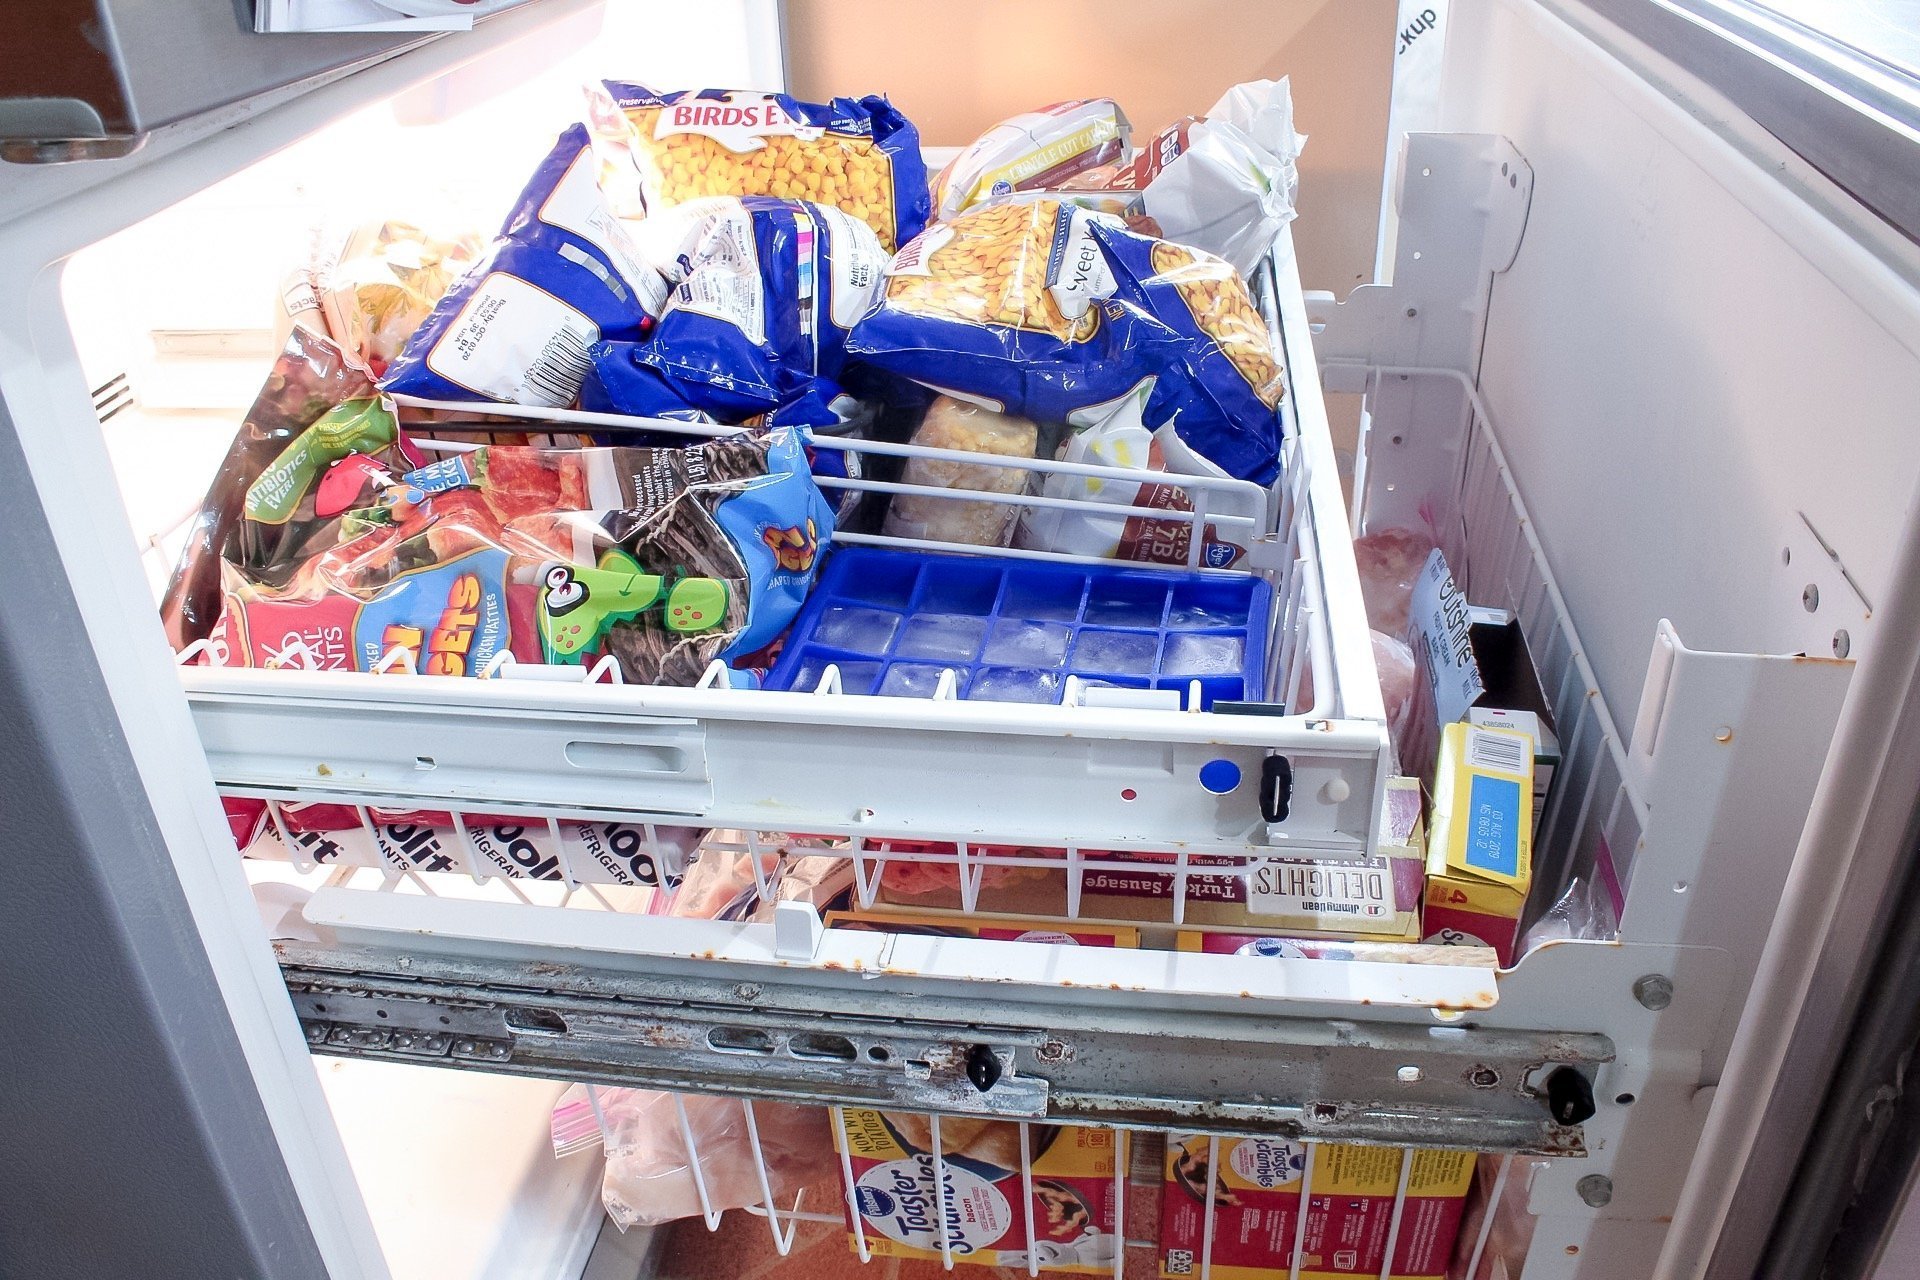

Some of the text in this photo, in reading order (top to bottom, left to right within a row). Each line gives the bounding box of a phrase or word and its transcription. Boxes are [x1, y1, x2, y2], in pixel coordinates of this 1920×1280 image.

[674, 106, 759, 127] BIRDS
[1008, 148, 1057, 180] CRINKLE
[1058, 139, 1078, 157] CUT
[858, 264, 869, 288] Facts
[1066, 245, 1098, 292] Sweet
[290, 295, 320, 311] acts
[492, 298, 507, 315] Best
[469, 321, 480, 334] 39
[484, 313, 495, 327] By:
[457, 338, 470, 351] B4
[475, 326, 486, 345] OCT
[541, 331, 564, 359] 14500
[462, 349, 472, 361] 20
[523, 356, 544, 382] 02439
[246, 450, 307, 512] ANTIBIOTICS
[264, 476, 297, 511] EVER!
[634, 475, 644, 506] processed
[645, 466, 655, 507] ingredients
[426, 573, 481, 677] GETS
[485, 592, 497, 634] PATTIES
[1438, 576, 1474, 669] Outshine
[324, 626, 348, 672] NTS
[1434, 611, 1445, 631] FRUIT
[1441, 637, 1452, 667] CREAM
[365, 642, 379, 672] OKED
[374, 826, 410, 872] RANTS
[386, 823, 455, 873] olit
[1489, 811, 1503, 859] 03 AUG 2019
[1085, 875, 1162, 895] Sausage
[1256, 867, 1383, 901] DELIGHTS
[1447, 889, 1467, 904] 4
[854, 1132, 867, 1153] NOW
[866, 1111, 888, 1152] POTATOES
[1092, 1134, 1103, 1146] 180
[1272, 1144, 1291, 1181] Toaster
[860, 1188, 883, 1216] Pillsbury
[891, 1170, 934, 1235] Toaster
[965, 1197, 977, 1223] bacon
